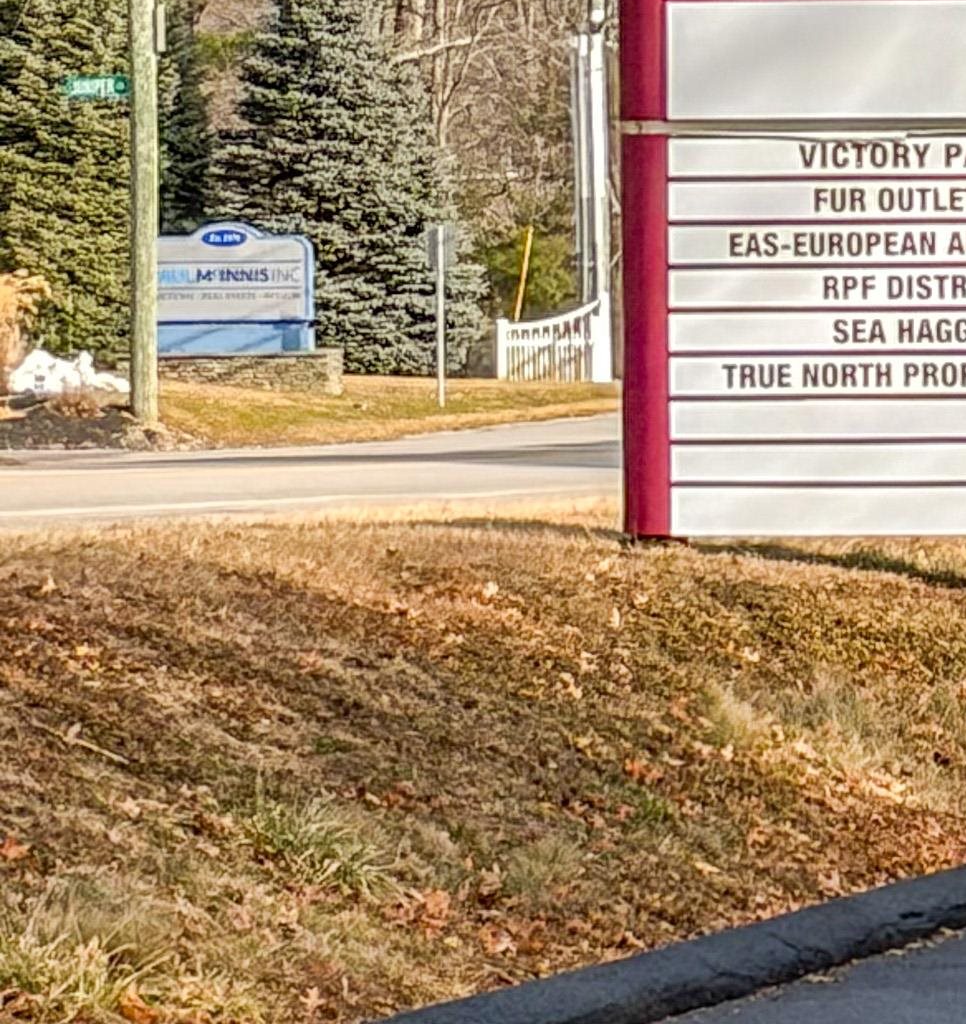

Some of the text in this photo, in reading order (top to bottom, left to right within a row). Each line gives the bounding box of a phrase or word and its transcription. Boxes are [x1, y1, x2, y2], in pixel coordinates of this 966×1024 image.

[799, 143, 930, 169] VICTORY
[814, 188, 866, 213] FUR
[729, 232, 936, 257] EAS-EUROPEAN
[823, 275, 875, 299] RPF
[833, 319, 885, 344] SEA
[722, 364, 791, 388] TRUE
[802, 363, 892, 388] NORTH
